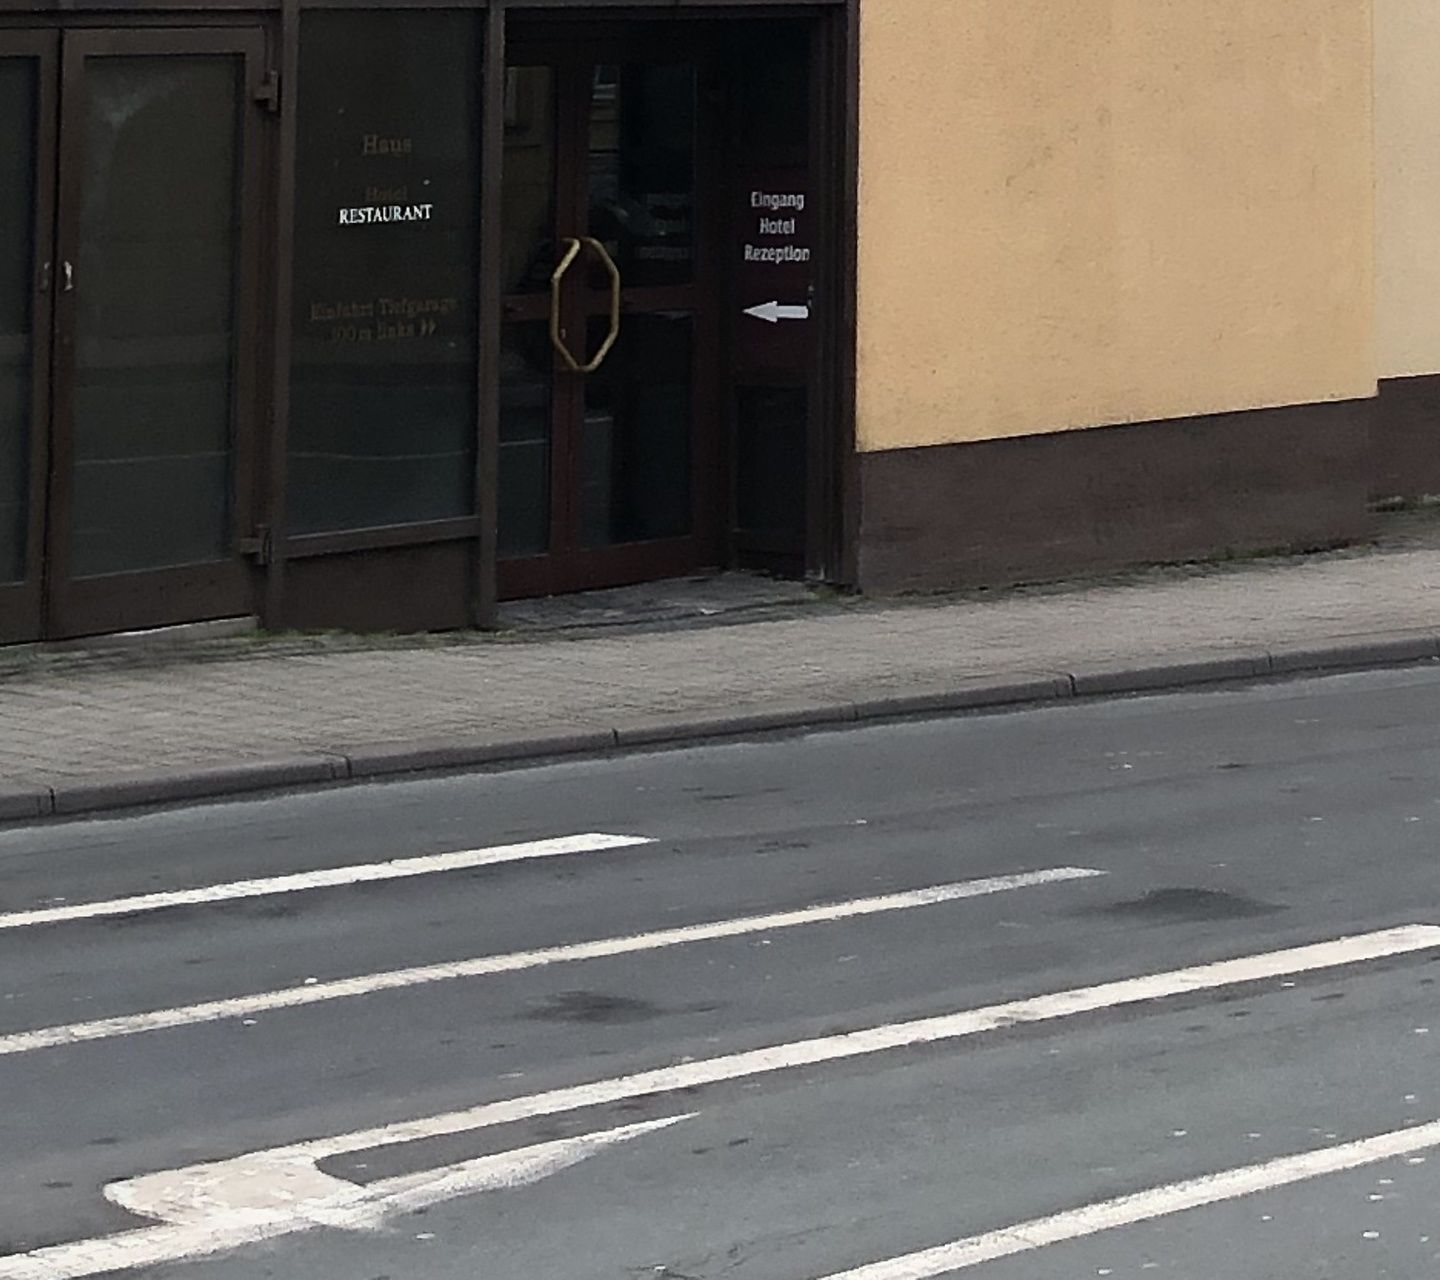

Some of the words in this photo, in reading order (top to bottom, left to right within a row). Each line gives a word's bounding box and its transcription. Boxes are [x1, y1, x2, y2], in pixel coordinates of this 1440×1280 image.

[750, 191, 805, 211] Eingang
[338, 203, 433, 225] RESTAURANT
[759, 217, 795, 235] Hotel
[744, 243, 810, 265] Rezeption
